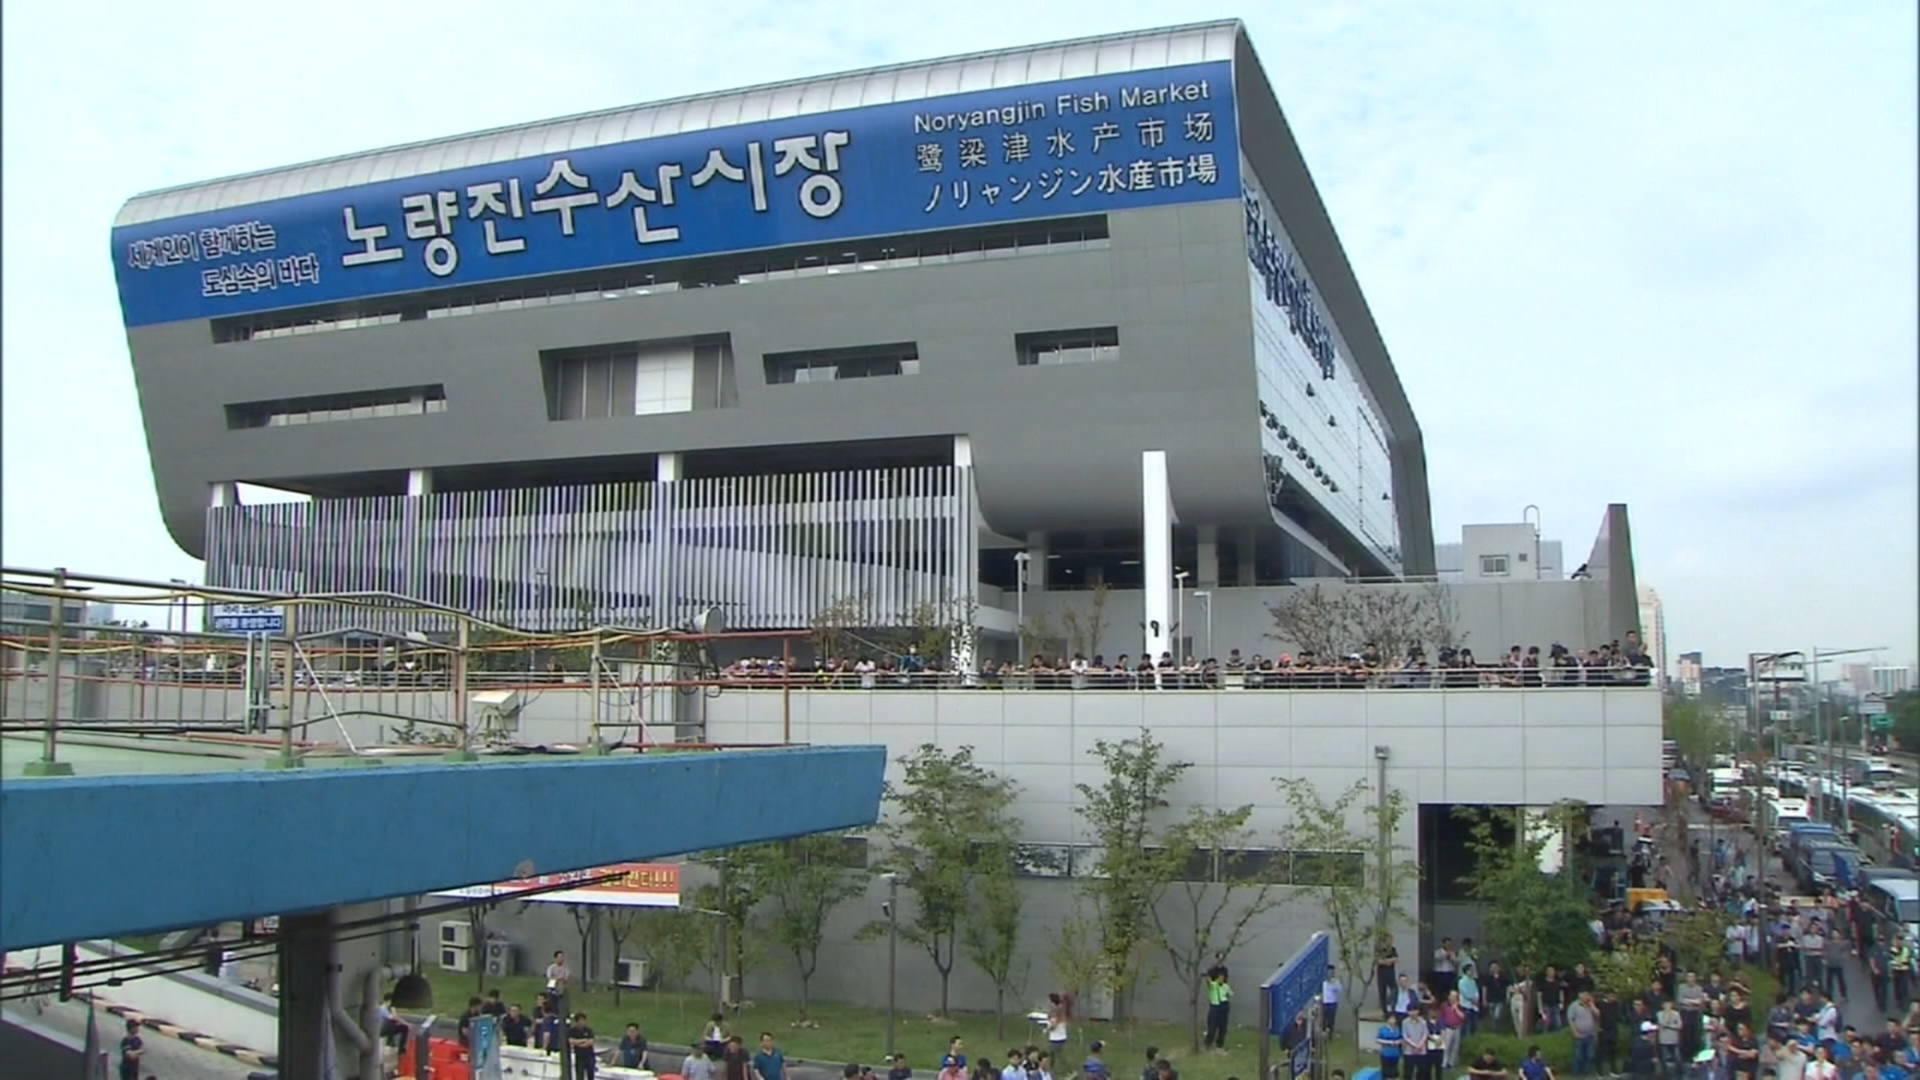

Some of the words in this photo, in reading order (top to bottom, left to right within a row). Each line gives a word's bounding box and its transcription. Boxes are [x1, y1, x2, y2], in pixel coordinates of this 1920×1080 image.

[913, 100, 1046, 134] Noryangjin
[1057, 92, 1109, 116] Fish
[1120, 79, 1210, 109] Market
[916, 110, 1214, 174] 鹭梁津水产市场
[341, 130, 850, 277] 노량진수산시장
[923, 153, 1218, 214] ノリャンジン水産市場
[127, 231, 199, 270] 세계인이
[200, 220, 277, 260] 함께하는
[202, 258, 278, 297] 도심속의
[278, 252, 319, 287] 바다
